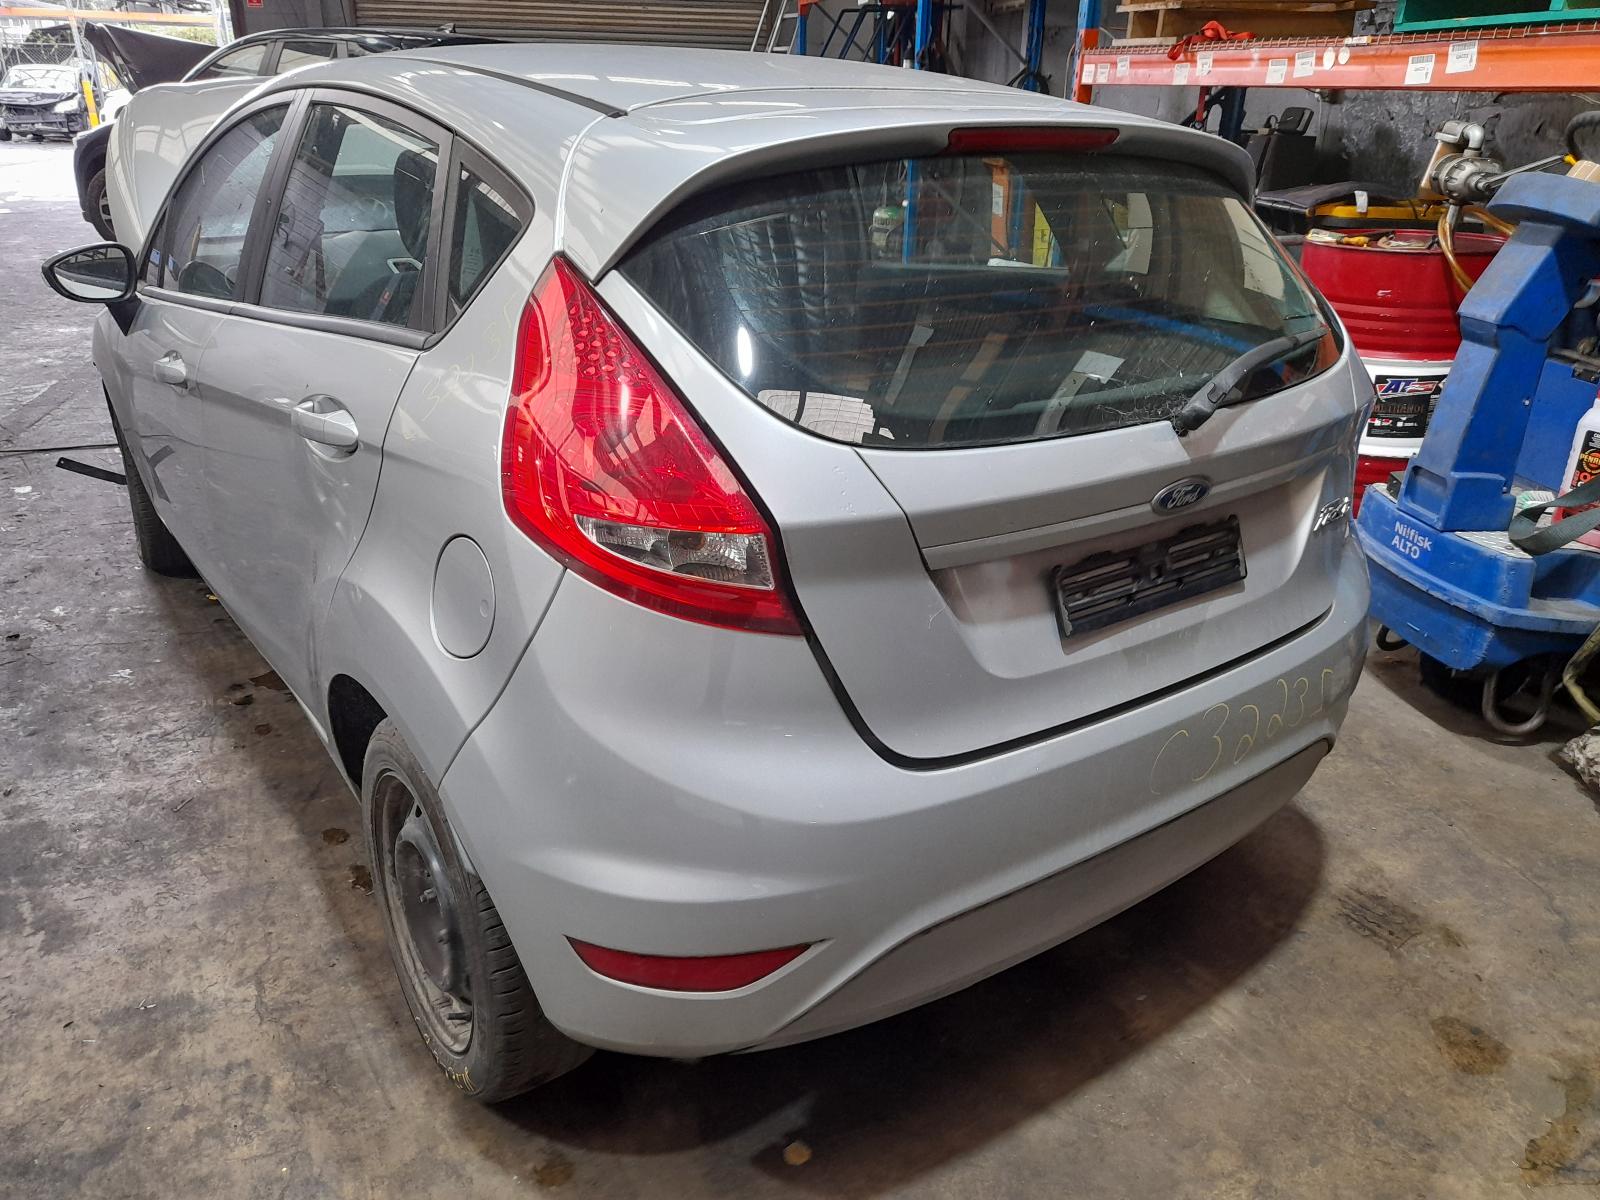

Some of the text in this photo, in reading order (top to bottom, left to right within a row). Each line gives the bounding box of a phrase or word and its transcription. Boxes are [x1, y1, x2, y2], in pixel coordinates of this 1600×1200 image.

[1167, 484, 1202, 509] Ford
[1391, 535, 1420, 559] ALTO
[1394, 520, 1432, 551] Nilfisk
